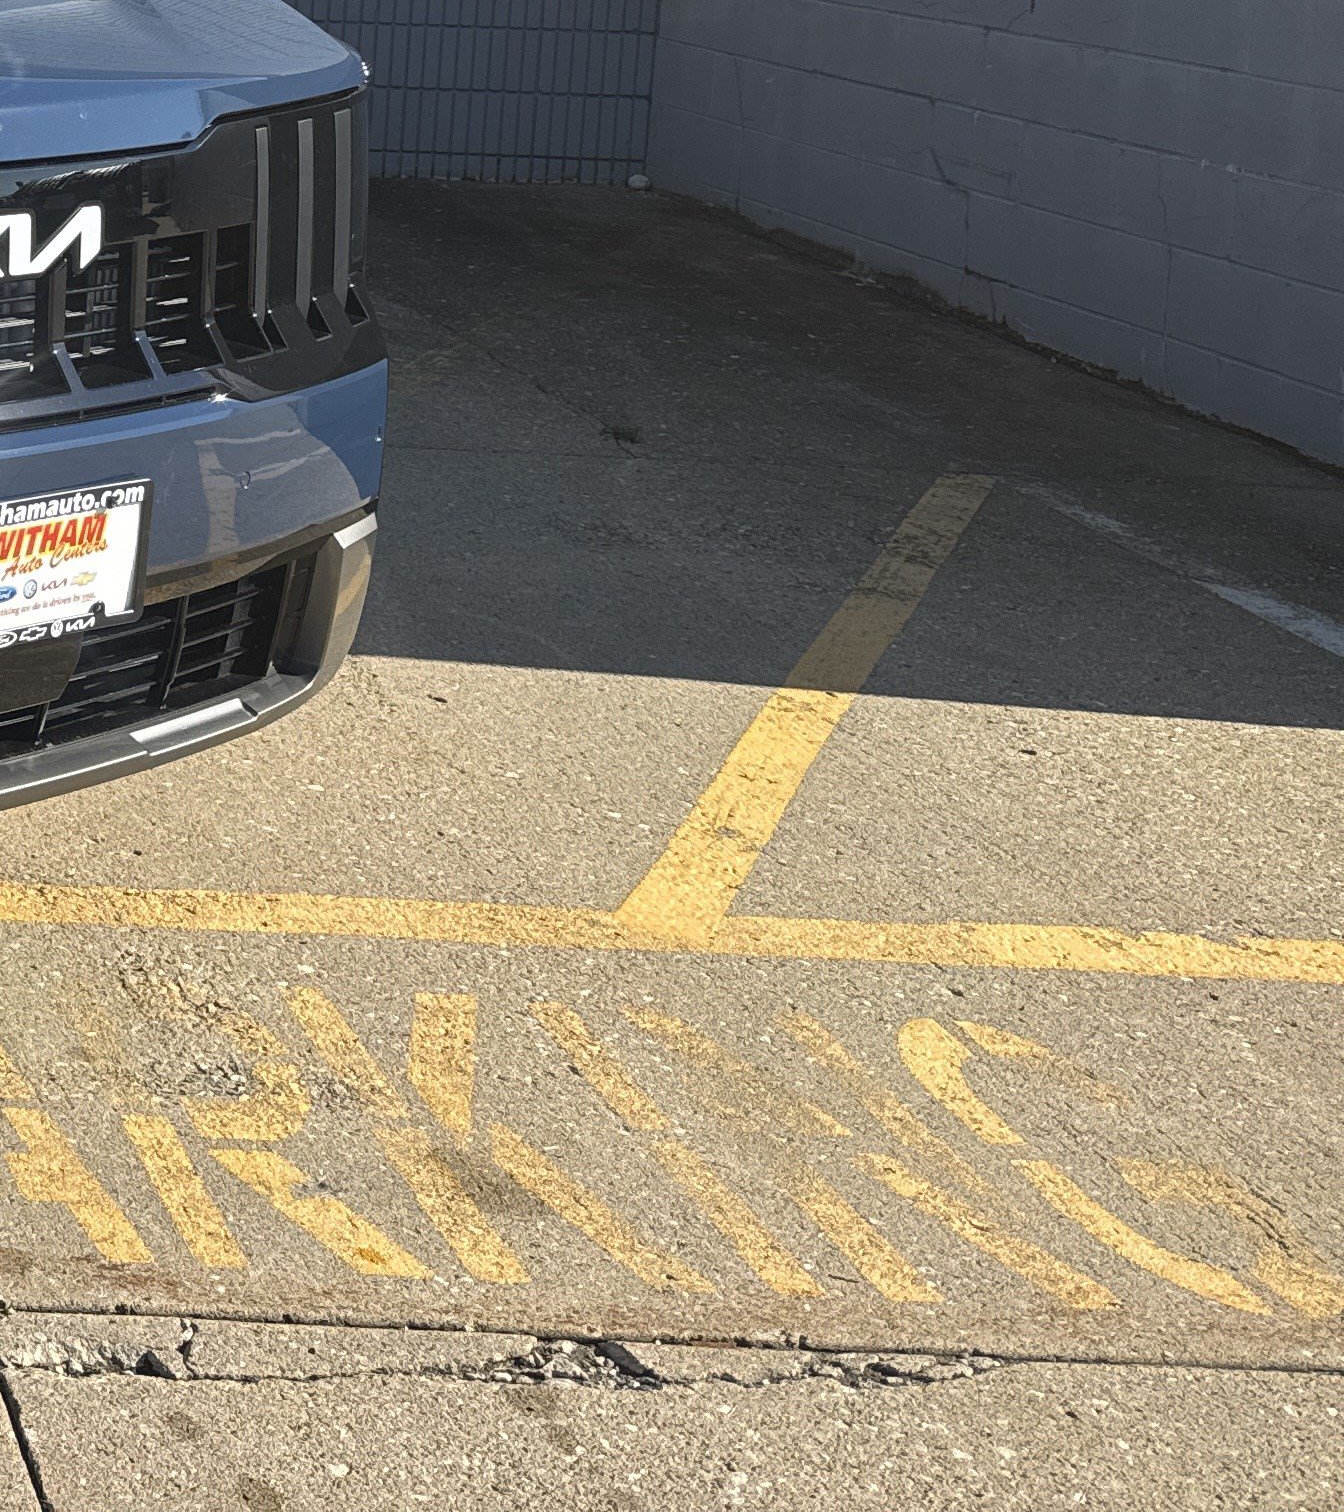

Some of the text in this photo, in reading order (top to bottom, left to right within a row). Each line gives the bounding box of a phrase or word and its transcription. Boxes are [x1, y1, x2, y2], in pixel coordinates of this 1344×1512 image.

[1, 539, 108, 582] Auto Centers
[65, 616, 96, 633] KIA
